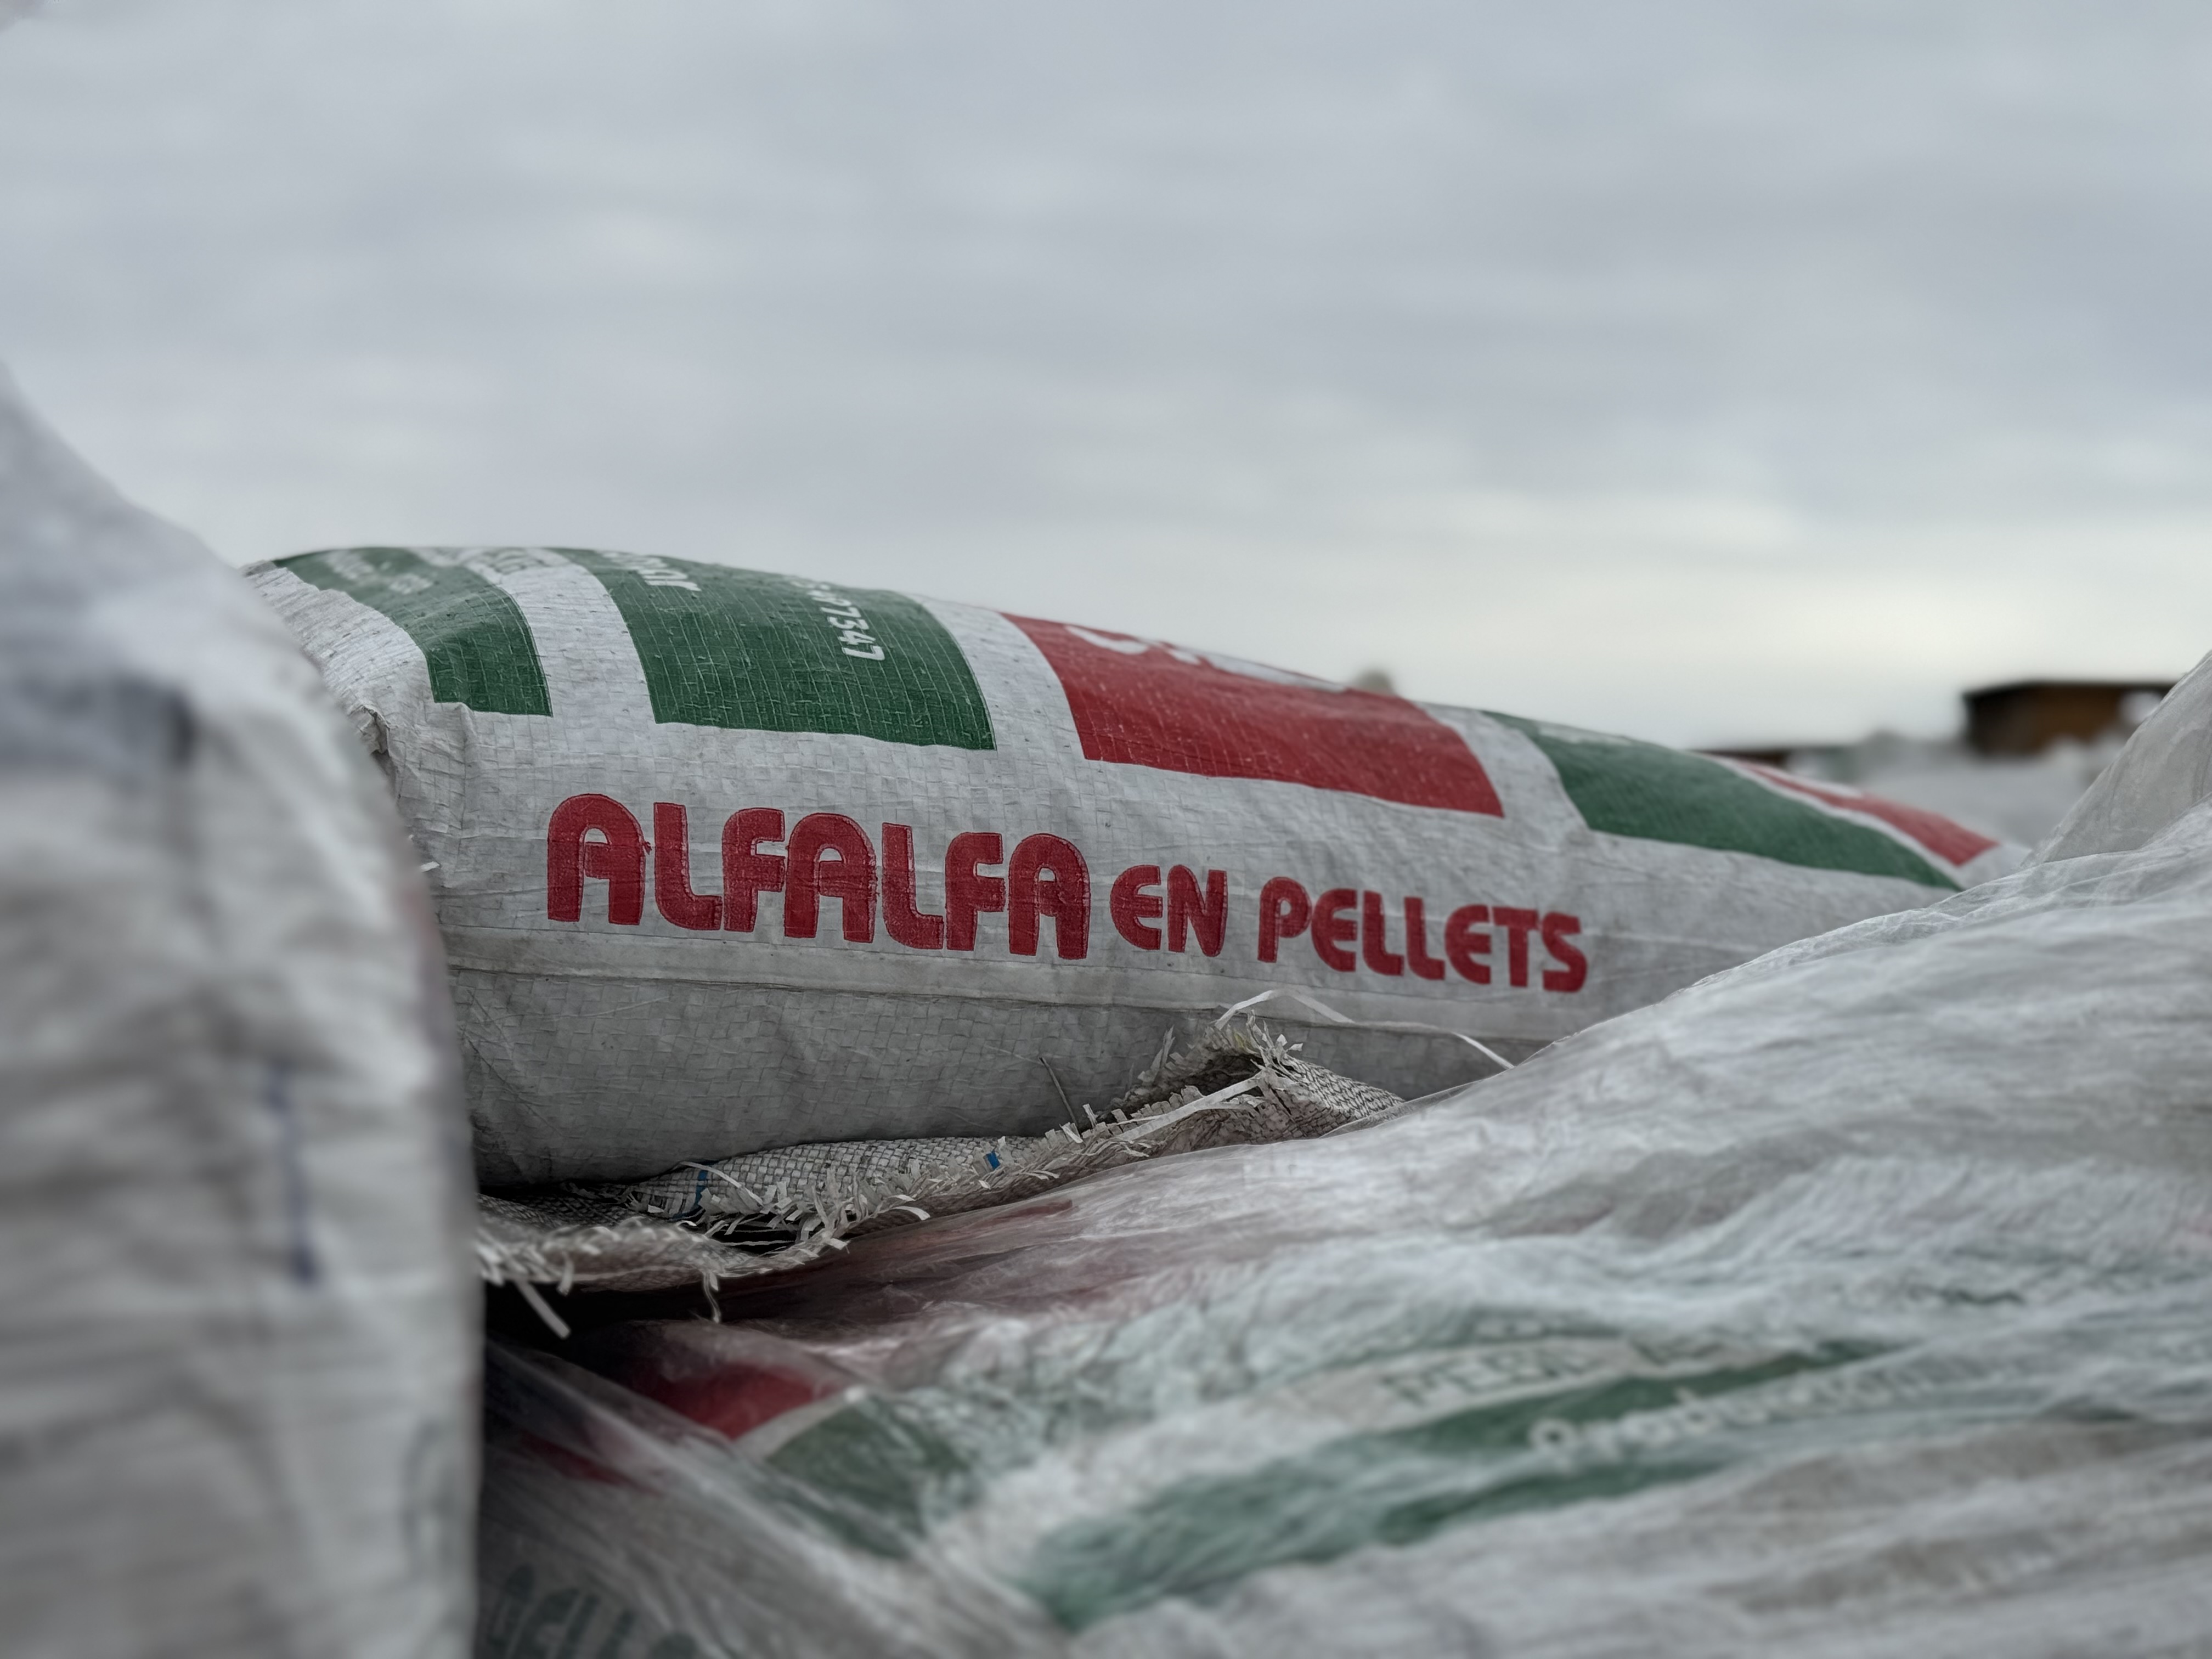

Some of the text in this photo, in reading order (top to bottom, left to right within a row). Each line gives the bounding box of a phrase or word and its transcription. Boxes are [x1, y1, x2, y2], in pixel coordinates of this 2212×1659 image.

[547, 793, 1588, 993] ALFALFA EN PELLETS
